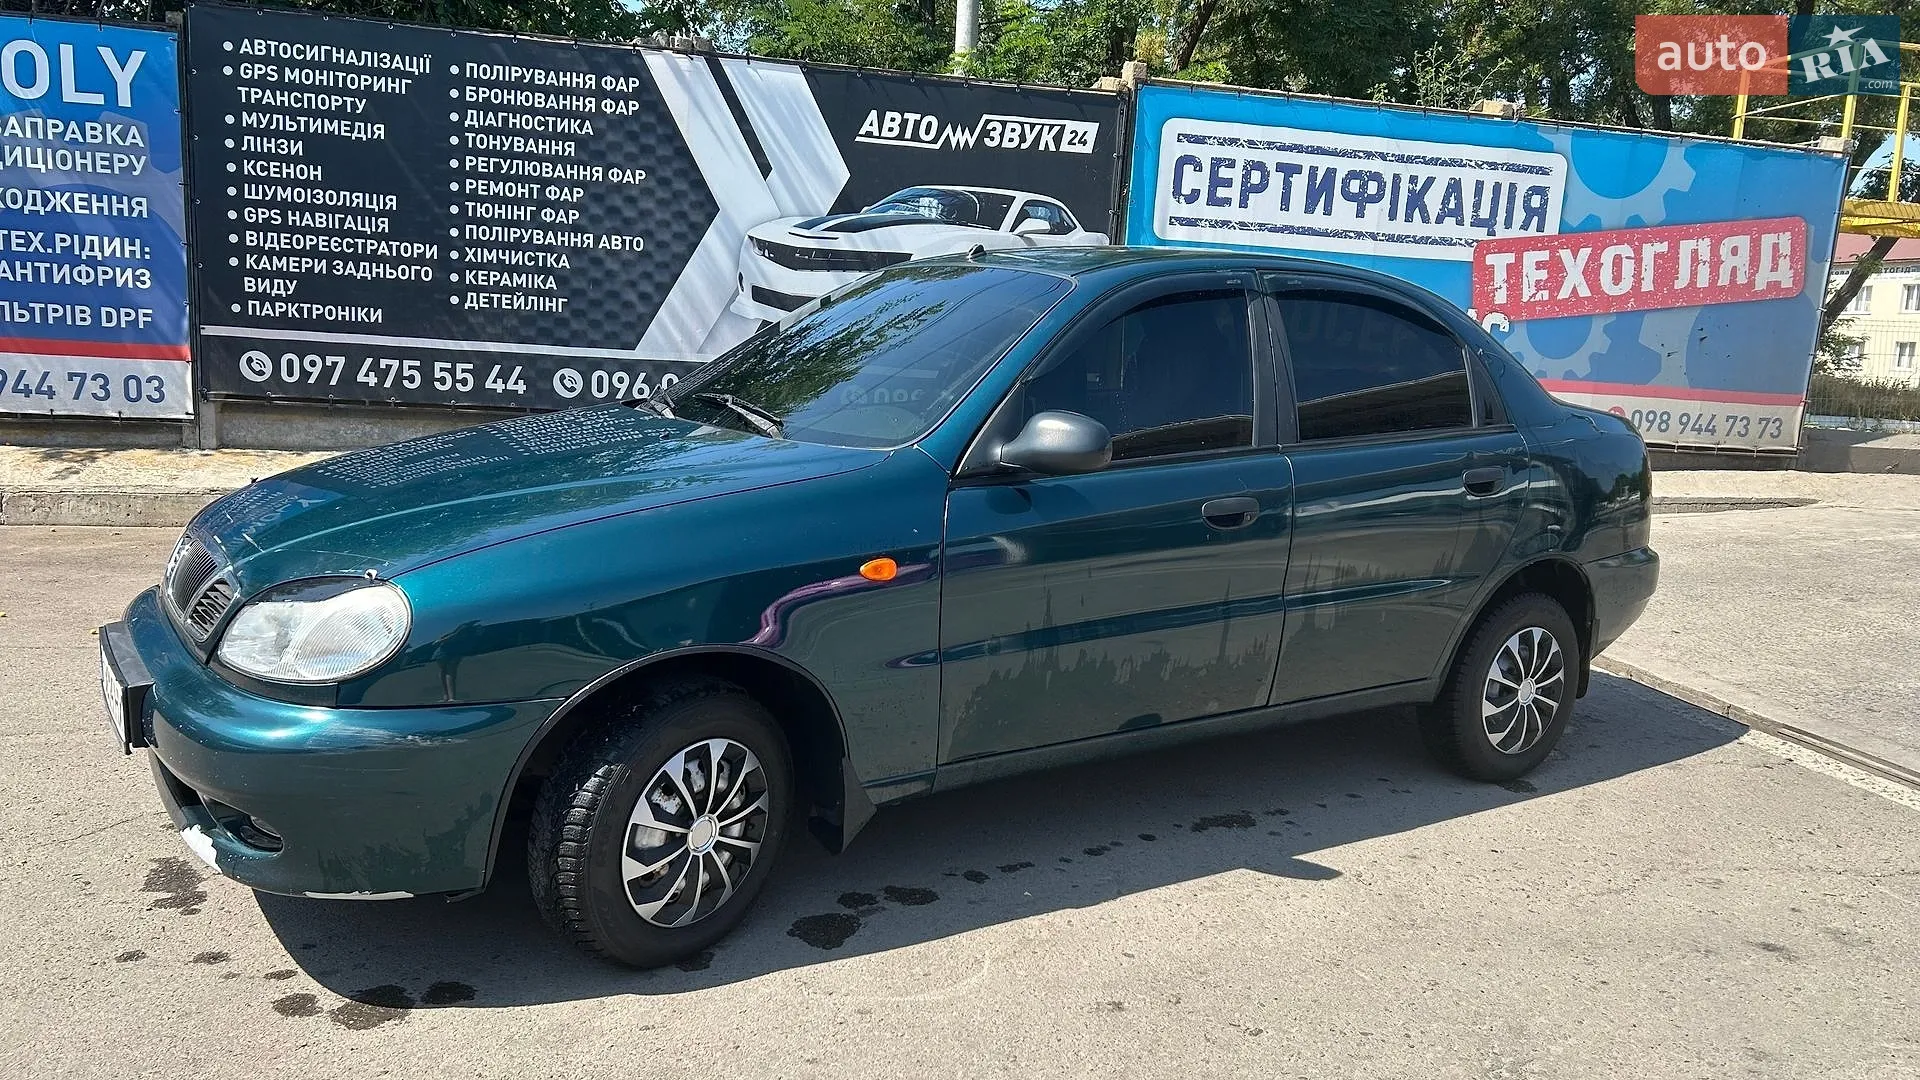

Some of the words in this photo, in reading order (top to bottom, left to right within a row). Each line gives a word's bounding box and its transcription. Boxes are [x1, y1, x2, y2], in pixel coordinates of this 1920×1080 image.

[240, 39, 431, 74] АВТОСИГНАЛІЗАЦІЇ
[240, 63, 278, 81] GPS
[285, 67, 411, 94] МОНІТОРИНГ
[466, 63, 595, 89] ПОЛІРУВАННЯ
[601, 76, 639, 92] ФАР
[237, 87, 366, 113] ТРАНСПОРТУ
[466, 86, 595, 112] БРОНЮВАННЯ
[601, 98, 639, 115] ФАР
[0, 116, 144, 148] АПРАВКА
[243, 112, 384, 141] МУЛЬТИМЕДІЯ
[465, 110, 593, 135] ДІАГНОСТИКА
[857, 109, 938, 142] АВТО
[984, 121, 1064, 151] ЗВУК
[1067, 129, 1089, 146] 24
[242, 136, 302, 155] ЛІНЗИ
[465, 133, 574, 156] ТОНУВАННЯ
[0, 145, 146, 176] ИЦІОНЕРУ
[244, 160, 321, 181] КСЕНОН
[466, 156, 602, 181] РЕГУЛЮВАННЯ
[608, 168, 646, 184] ФАР
[245, 184, 396, 212] ШУМОІЗОЛЯЦІЯ
[466, 179, 540, 199] РЕМОНТ
[546, 185, 584, 202] ФАР
[1171, 153, 1550, 235] СЕРТИФІКАЦІЯ
[244, 207, 281, 224] GPS
[288, 211, 388, 234] НАВІГАЦІЯ
[465, 202, 536, 221] ТЮНІНГ
[541, 208, 579, 224] ФАР
[246, 231, 437, 259] ВІДЕОРЕЄСТРАТОРИ
[466, 225, 593, 248] ПОЛІРУВАННЯ
[598, 235, 643, 251] АВТО
[246, 254, 326, 274] КАМЕРИ
[333, 260, 432, 281] ЗАДНЬОГО
[465, 247, 570, 268] ХІМЧИСТКА
[1485, 232, 1794, 304] ТЕХОГЛЯД
[0, 260, 152, 290] АНТИФРИЗ
[244, 277, 297, 297] ВИДУ
[466, 270, 557, 290] КЕРАМІКА
[248, 300, 382, 323] ПАРКТРОНІКИ
[465, 292, 567, 312] ДЕТЕЙЛІНГ
[101, 306, 153, 329] DPF
[67, 371, 111, 402] 73
[123, 374, 166, 404] 03
[281, 353, 345, 385] 097
[357, 358, 421, 389] 475
[434, 362, 473, 391] 55
[485, 365, 526, 394] 44
[591, 370, 650, 399] 096
[1631, 409, 1672, 433] 098
[1678, 412, 1717, 436] 944
[1725, 414, 1750, 438] 73
[1758, 417, 1783, 439] 73
